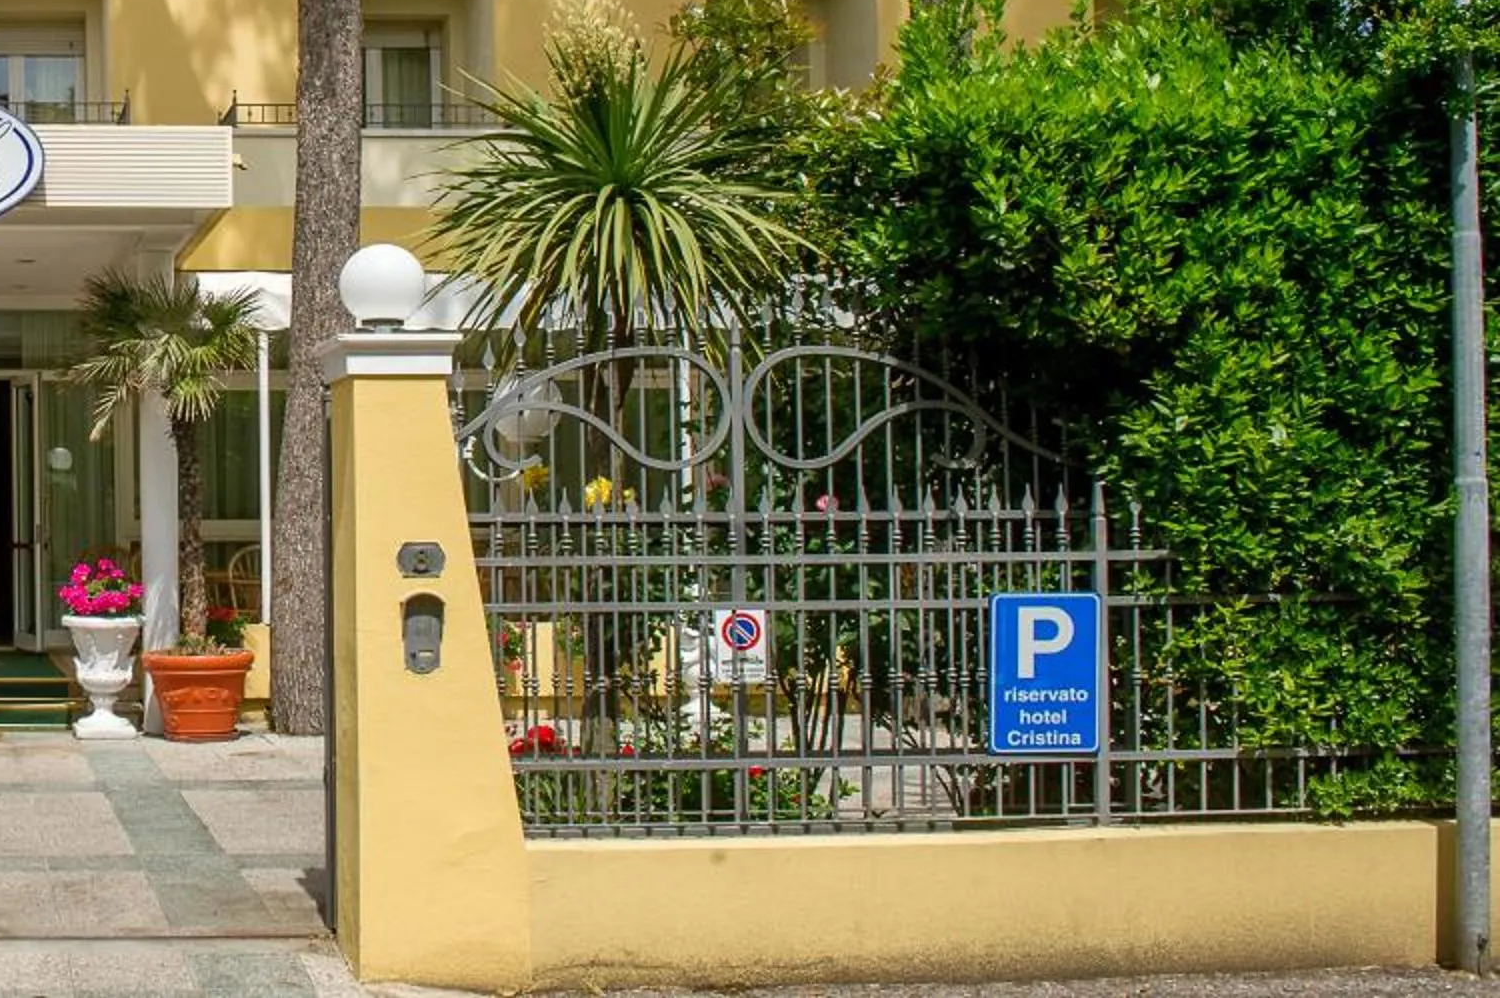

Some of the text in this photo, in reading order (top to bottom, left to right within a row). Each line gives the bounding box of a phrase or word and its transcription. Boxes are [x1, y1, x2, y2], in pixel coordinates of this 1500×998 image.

[1017, 606, 1074, 679] P
[1004, 686, 1089, 702] riservato
[1019, 709, 1067, 725] hotel
[1007, 730, 1082, 746] Cristina
